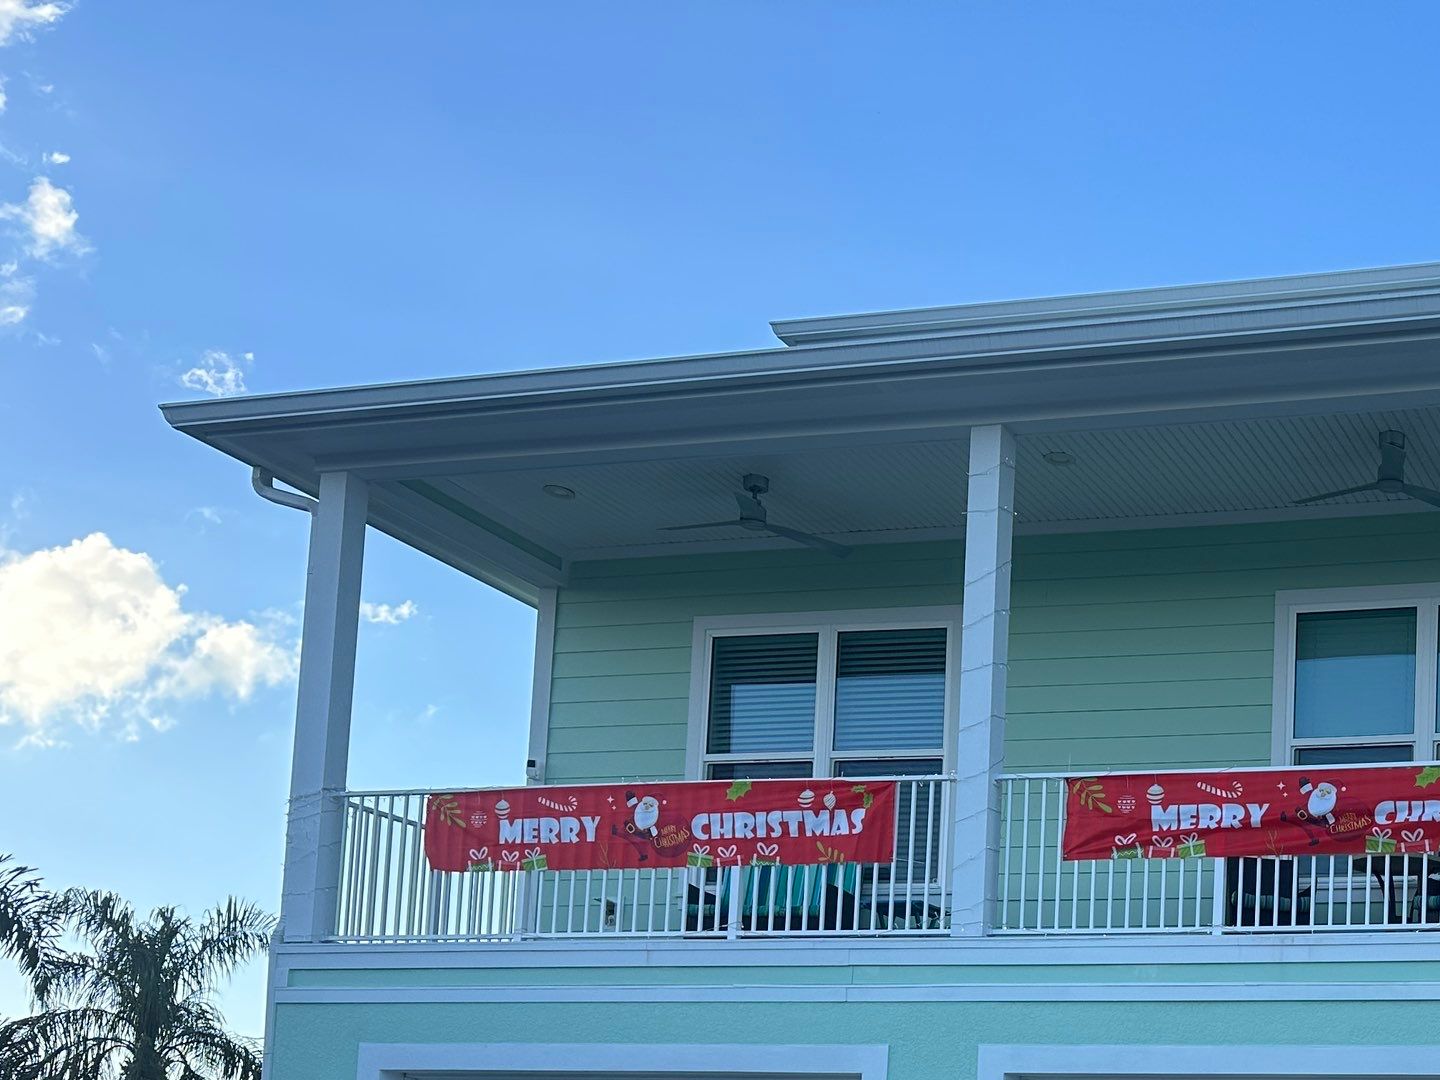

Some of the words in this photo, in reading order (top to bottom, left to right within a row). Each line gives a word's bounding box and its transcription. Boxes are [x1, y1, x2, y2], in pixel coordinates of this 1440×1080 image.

[499, 815, 601, 844] MERRY
[691, 808, 866, 841] CHRISTMAS
[1151, 803, 1270, 832] MERRY
